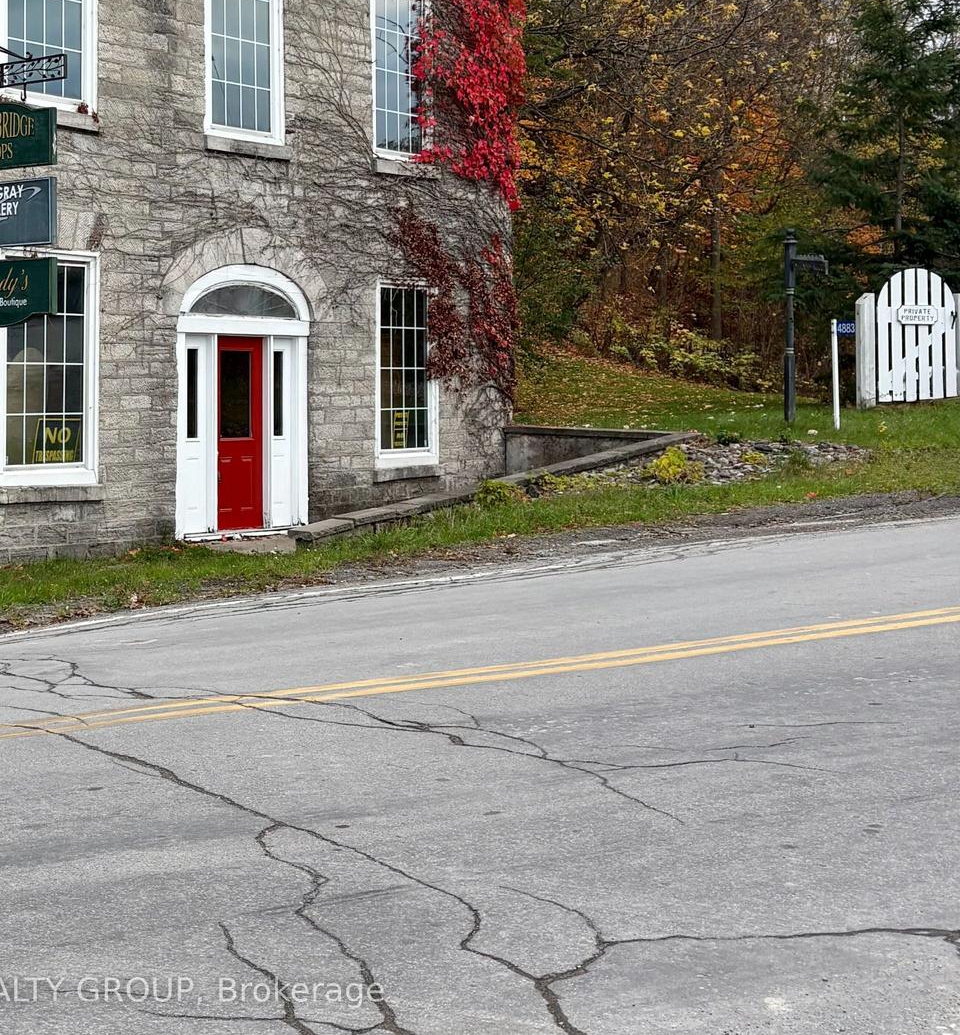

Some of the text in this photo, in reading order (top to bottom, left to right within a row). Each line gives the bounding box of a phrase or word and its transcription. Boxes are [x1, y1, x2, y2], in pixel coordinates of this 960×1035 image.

[0, 297, 28, 308] Boutique
[44, 427, 71, 444] NO
[35, 449, 74, 462] TRSPASSNG
